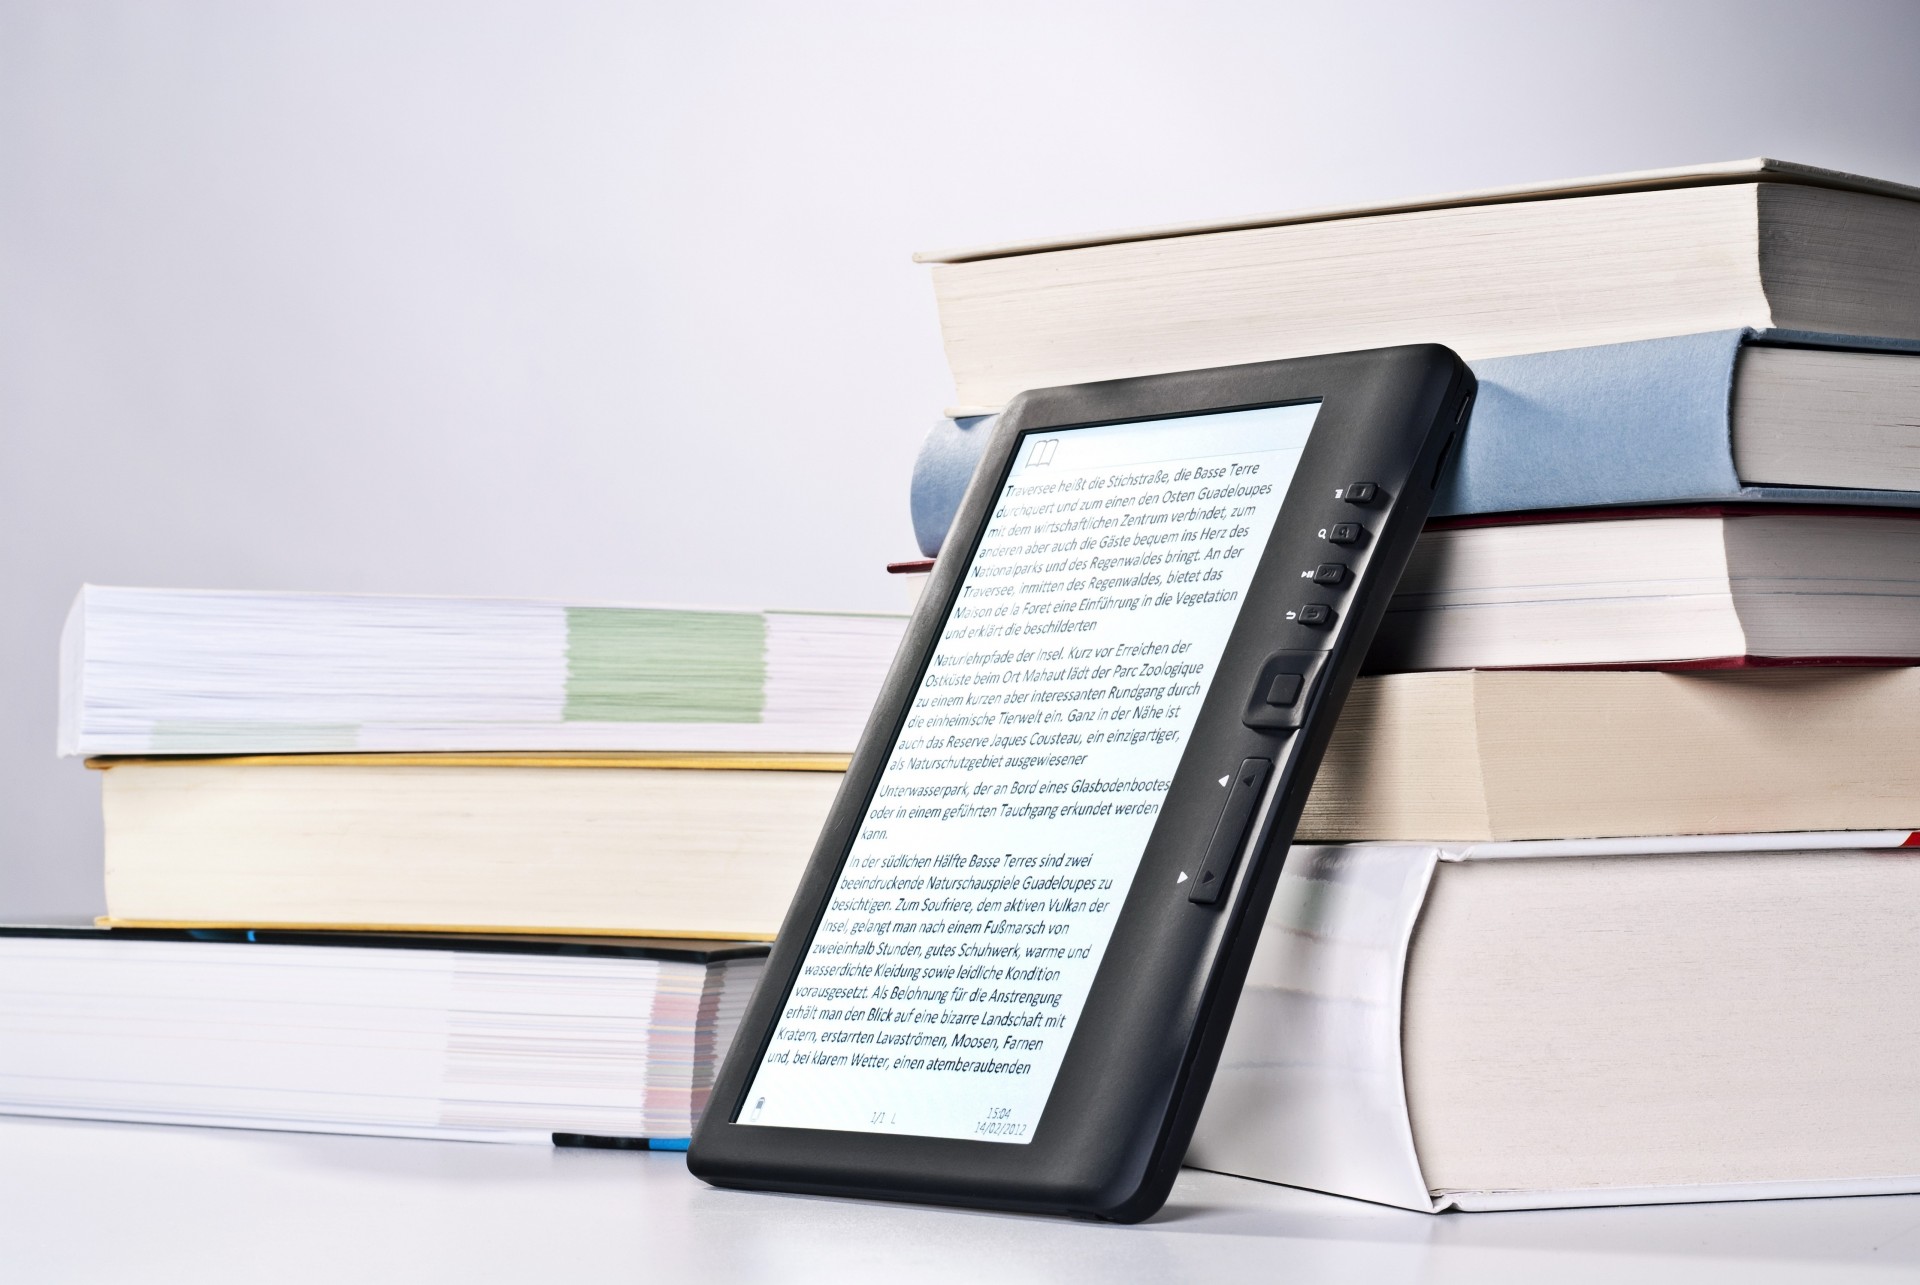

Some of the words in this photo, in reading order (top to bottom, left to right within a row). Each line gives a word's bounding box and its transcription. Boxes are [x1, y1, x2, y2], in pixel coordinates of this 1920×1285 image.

[1005, 483, 1056, 498] Traversee
[1057, 477, 1087, 492] heißt
[1106, 469, 1169, 488] Stichstraße,
[1193, 466, 1226, 480] Basse
[1229, 462, 1260, 476] Terre
[1056, 498, 1080, 513] und
[1078, 499, 1103, 510] zum
[1104, 495, 1136, 509] einen
[1137, 491, 1159, 506] den
[1161, 490, 1195, 504] Osten
[1197, 482, 1273, 500] Guadeloupes
[1007, 523, 1031, 536] dem
[1033, 515, 1119, 534] wirtschaftlichen
[1119, 513, 1169, 527] Zentrum
[1170, 505, 1227, 523] verbindet,
[1230, 505, 1256, 518] zum
[978, 544, 1023, 558] anderen
[1024, 541, 1051, 554] aber
[1050, 537, 1077, 553] auch
[1098, 534, 1131, 549] Gäste
[1132, 531, 1179, 547] bequem
[1199, 526, 1228, 540] Herz
[1228, 523, 1250, 539] des
[970, 560, 1044, 578] Nationalparks
[1045, 558, 1068, 573] und
[1067, 557, 1088, 571] des
[1088, 551, 1163, 572] Regenwaldes
[1164, 548, 1200, 565] bringt.
[1222, 544, 1245, 560] der
[963, 585, 1015, 598] Traversee,
[1018, 580, 1064, 594] inmitten
[1065, 577, 1086, 591] des
[1087, 571, 1162, 592] Regenwaldes,
[1165, 569, 1202, 584] bietet
[1202, 566, 1224, 582] das
[953, 606, 992, 619] Maison
[1021, 601, 1052, 615] Foret
[1052, 599, 1077, 613] eine
[1077, 595, 1141, 611] Einführung
[1175, 588, 1238, 607] Vegetation
[944, 625, 968, 640] und
[967, 623, 1004, 639] erklärt
[1022, 619, 1097, 635] beschilderten
[933, 649, 1014, 667] Naturlehrpfade
[1015, 648, 1036, 662] der
[1036, 646, 1064, 661] Insel.
[1067, 646, 1093, 660] Kurz
[1094, 647, 1115, 658] vor
[1114, 640, 1169, 657] Erreichen
[1170, 639, 1192, 654] der
[925, 673, 971, 687] Ostküste
[972, 671, 1000, 685] beim
[1021, 667, 1067, 683] Mahaut
[1066, 665, 1090, 681] lädt
[1090, 664, 1112, 679] der
[1112, 664, 1138, 678] Parc
[1138, 660, 1204, 678] Zoologique
[930, 694, 964, 707] einem
[965, 691, 1002, 706] kurzen
[1003, 689, 1030, 704] aber
[1030, 687, 1106, 703] interessanten
[1107, 683, 1166, 701] Rundgang
[1166, 680, 1201, 697] durch
[926, 711, 996, 728] einheimische
[998, 709, 1043, 725] Tierwelt
[1067, 708, 1096, 723] Ganz
[1110, 705, 1132, 721] der
[1131, 704, 1164, 720] Nähe
[898, 736, 924, 750] auch
[925, 735, 945, 749] das
[945, 734, 989, 748] Reserve
[989, 733, 1028, 750] Jaques
[1029, 731, 1082, 746] Cousteau,
[1106, 727, 1180, 745] einzigartiger,
[906, 753, 1004, 772] Naturschutzgebiet
[1004, 752, 1088, 770] ausgewiesener
[879, 781, 970, 799] Unterwasserpark,
[972, 781, 993, 796] der
[1009, 779, 1039, 795] Bord
[1038, 780, 1070, 795] eines
[1070, 776, 1170, 794] Glasbodenbootes
[869, 805, 895, 819] oder
[908, 805, 942, 819] einem
[941, 803, 997, 821] geführten
[999, 802, 1060, 821] Tauchgang
[1059, 800, 1113, 816] erkundet
[1114, 799, 1159, 815] werden
[860, 826, 887, 840] kann.
[861, 853, 881, 869] der
[880, 853, 932, 869] südlichen
[932, 852, 967, 868] Hälfte
[967, 853, 1000, 869] Basse
[1003, 853, 1038, 868] Terres
[1038, 852, 1066, 868] sind
[1063, 853, 1094, 867] zwei
[839, 874, 924, 890] beeindruckende
[925, 874, 1020, 893] Naturschauspiele
[1021, 874, 1097, 893] Guadeloupes
[830, 896, 892, 914] besichtigen.
[894, 897, 920, 912] Zum
[920, 896, 973, 914] Soufriere,
[976, 896, 1002, 912] dem
[1003, 897, 1045, 912] aktiven
[1048, 897, 1087, 913] Vulkan
[1088, 897, 1110, 913] der
[821, 918, 849, 934] Insel,
[849, 918, 892, 936] gelangt
[891, 922, 917, 934] man
[918, 918, 945, 934] nach
[946, 919, 982, 935] einem
[983, 919, 1046, 935] Fußmarsch
[1048, 924, 1070, 935] von
[812, 940, 875, 956] zweieinhalb
[875, 941, 922, 958] Stunden,
[923, 943, 957, 960] gutes
[957, 941, 1021, 960] Schuhwerk,
[1025, 947, 1066, 959] warme
[1066, 943, 1092, 959] und
[804, 962, 873, 978] wasserdichte
[873, 962, 922, 982] Kleidung
[921, 964, 955, 980] sowie
[955, 964, 1003, 981] leidliche
[1004, 965, 1061, 982] Kondition
[795, 985, 868, 1001] vorausgesetzt.
[889, 985, 949, 1005] Belohnung
[987, 988, 1063, 1008] Anstrengung
[785, 1004, 818, 1020] erhält
[817, 1009, 843, 1021] man
[843, 1005, 866, 1022] den
[866, 1006, 893, 1023] Blick
[893, 1007, 916, 1023] auf
[913, 1008, 939, 1024] eine
[939, 1008, 979, 1026] bizarre
[980, 1010, 1044, 1028] Landschaft
[1043, 1013, 1067, 1029] mit
[776, 1026, 817, 1044] Kratern,
[820, 1029, 874, 1044] erstarrten
[875, 1030, 947, 1049] Lavaströmen,
[950, 1032, 999, 1052] Moosen,
[1002, 1034, 1043, 1051] Farnen
[767, 1049, 790, 1066] und,
[792, 1049, 812, 1065] bei
[810, 1050, 848, 1067] klarem
[850, 1052, 889, 1071] Wetter,
[892, 1054, 925, 1070] einen
[925, 1056, 1031, 1075] atemberaubenden
[986, 1107, 1011, 1120] 15:04
[973, 1121, 1027, 1136] 14/02/2012
